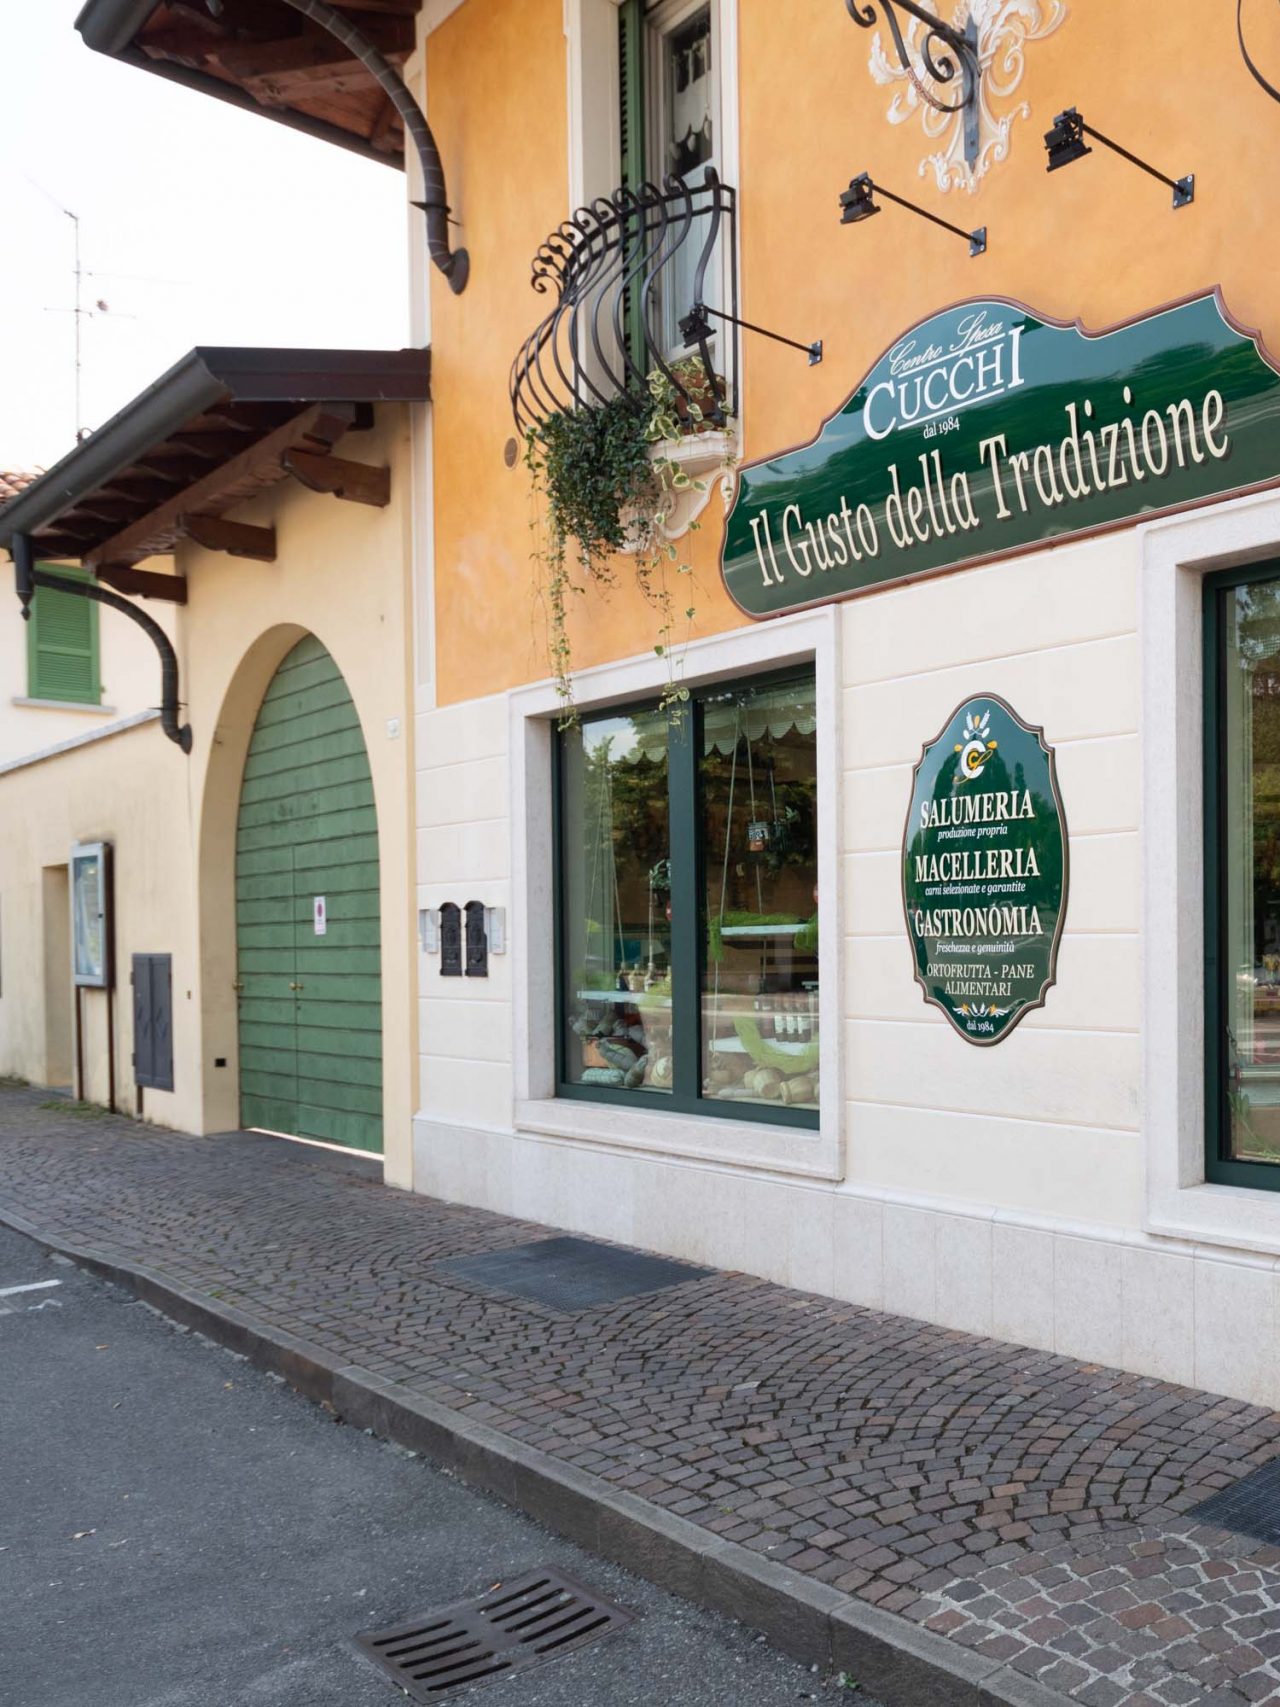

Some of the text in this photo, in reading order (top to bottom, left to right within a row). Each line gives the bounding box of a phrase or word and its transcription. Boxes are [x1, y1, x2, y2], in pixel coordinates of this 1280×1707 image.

[890, 311, 1003, 375] Centro Spesa
[863, 325, 1025, 440] CUCCHI
[923, 416, 961, 439] dal 1984
[749, 386, 1229, 586] Il Gusto della Tradizione
[920, 789, 1035, 828] SALUMERIA
[937, 823, 1008, 842] produzione propria
[915, 847, 1040, 882] MACELLERIA
[925, 881, 1026, 896] carni selezionate e garantite
[915, 906, 1044, 937] GASTRONOMIA
[935, 941, 970, 955] freschezza
[977, 941, 1015, 955] genuinità
[927, 963, 991, 978] ORTOFRUTTA
[1001, 965, 1035, 978] PANE
[945, 981, 1012, 996] ALIMENTARI
[966, 1020, 995, 1033] dal 1984
